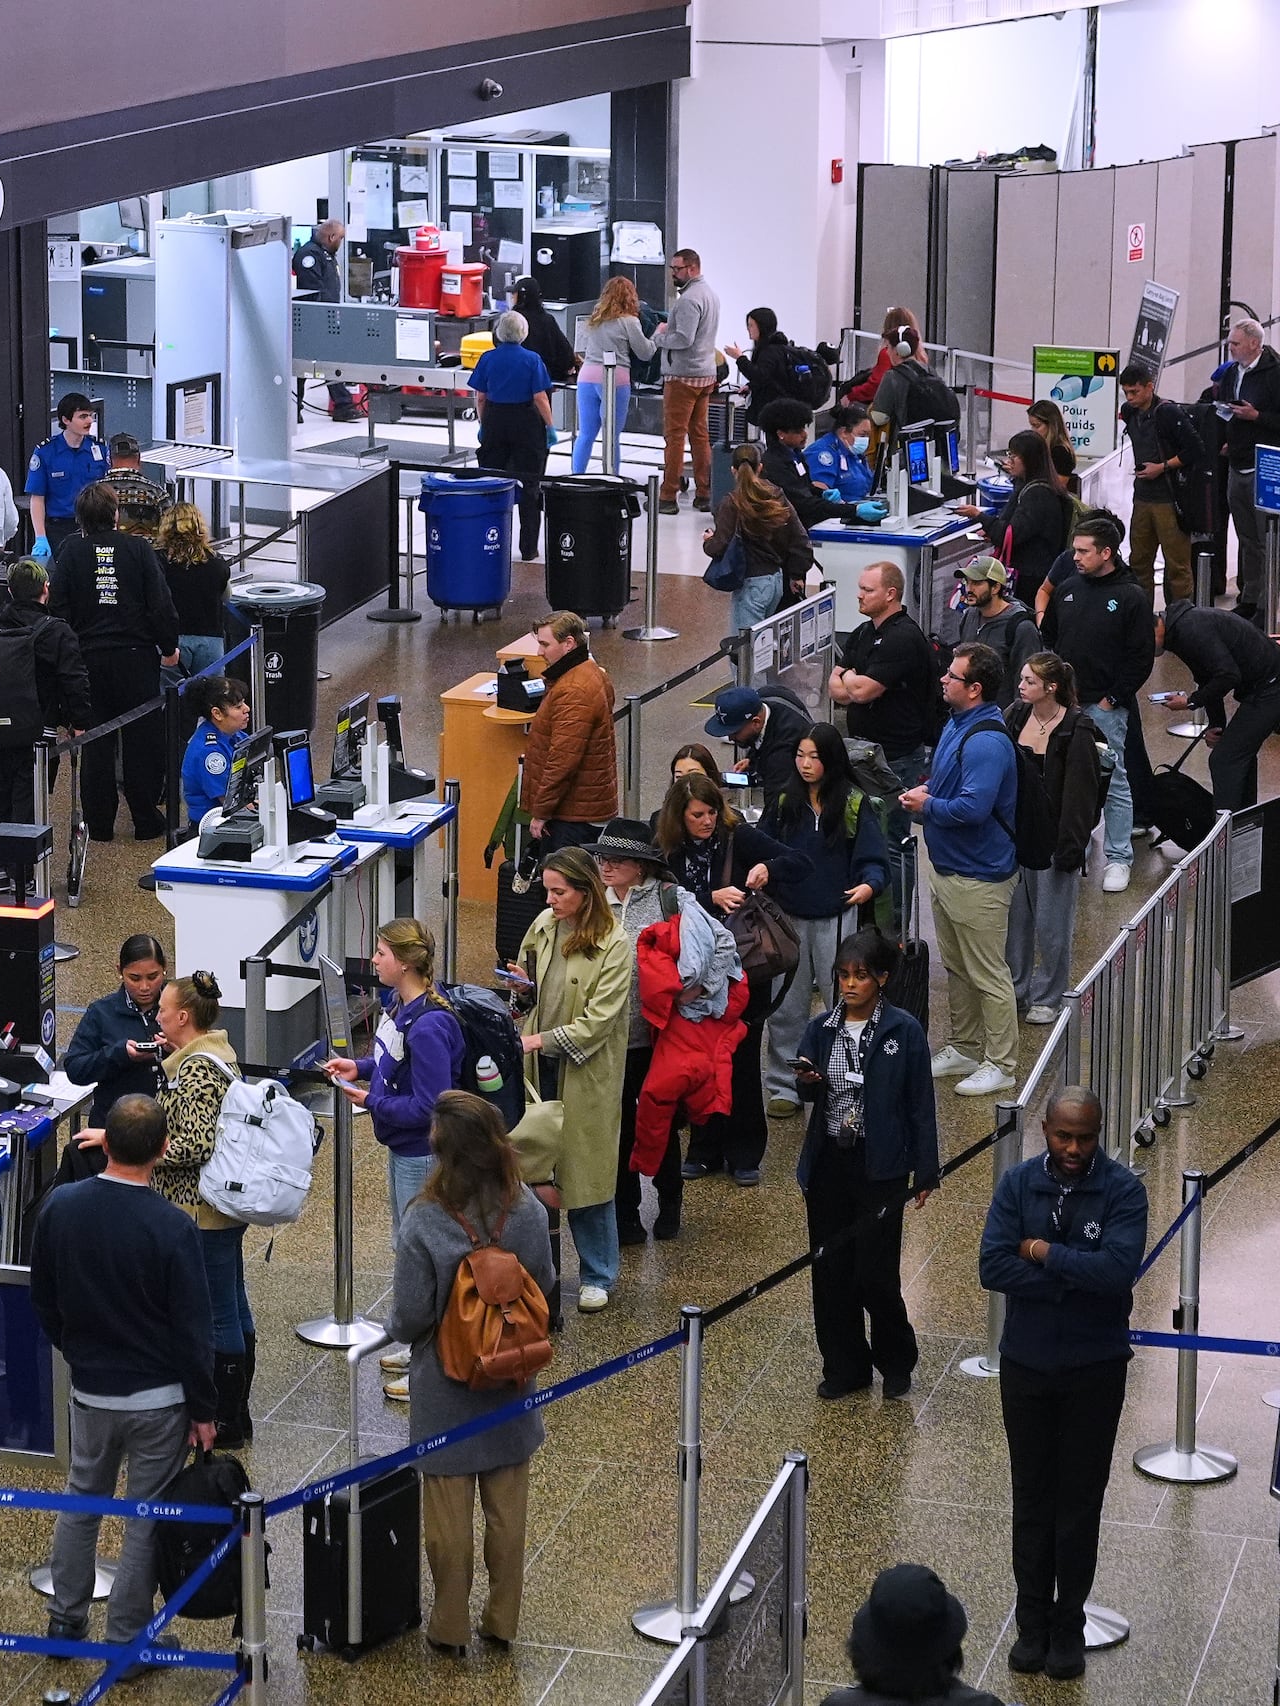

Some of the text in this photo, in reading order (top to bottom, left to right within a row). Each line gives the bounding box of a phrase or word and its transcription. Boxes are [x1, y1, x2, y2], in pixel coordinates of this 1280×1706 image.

[1062, 405, 1088, 416] Pour
[1065, 420, 1095, 431] quids
[1070, 435, 1091, 446] ere
[635, 1346, 655, 1359] CLEAR
[534, 1391, 554, 1404] CLEAR
[426, 1436, 447, 1450] CLEAR
[314, 1481, 335, 1495] CLEAR
[153, 1507, 183, 1516] CLEAR
[156, 1653, 186, 1662] CLEAR
